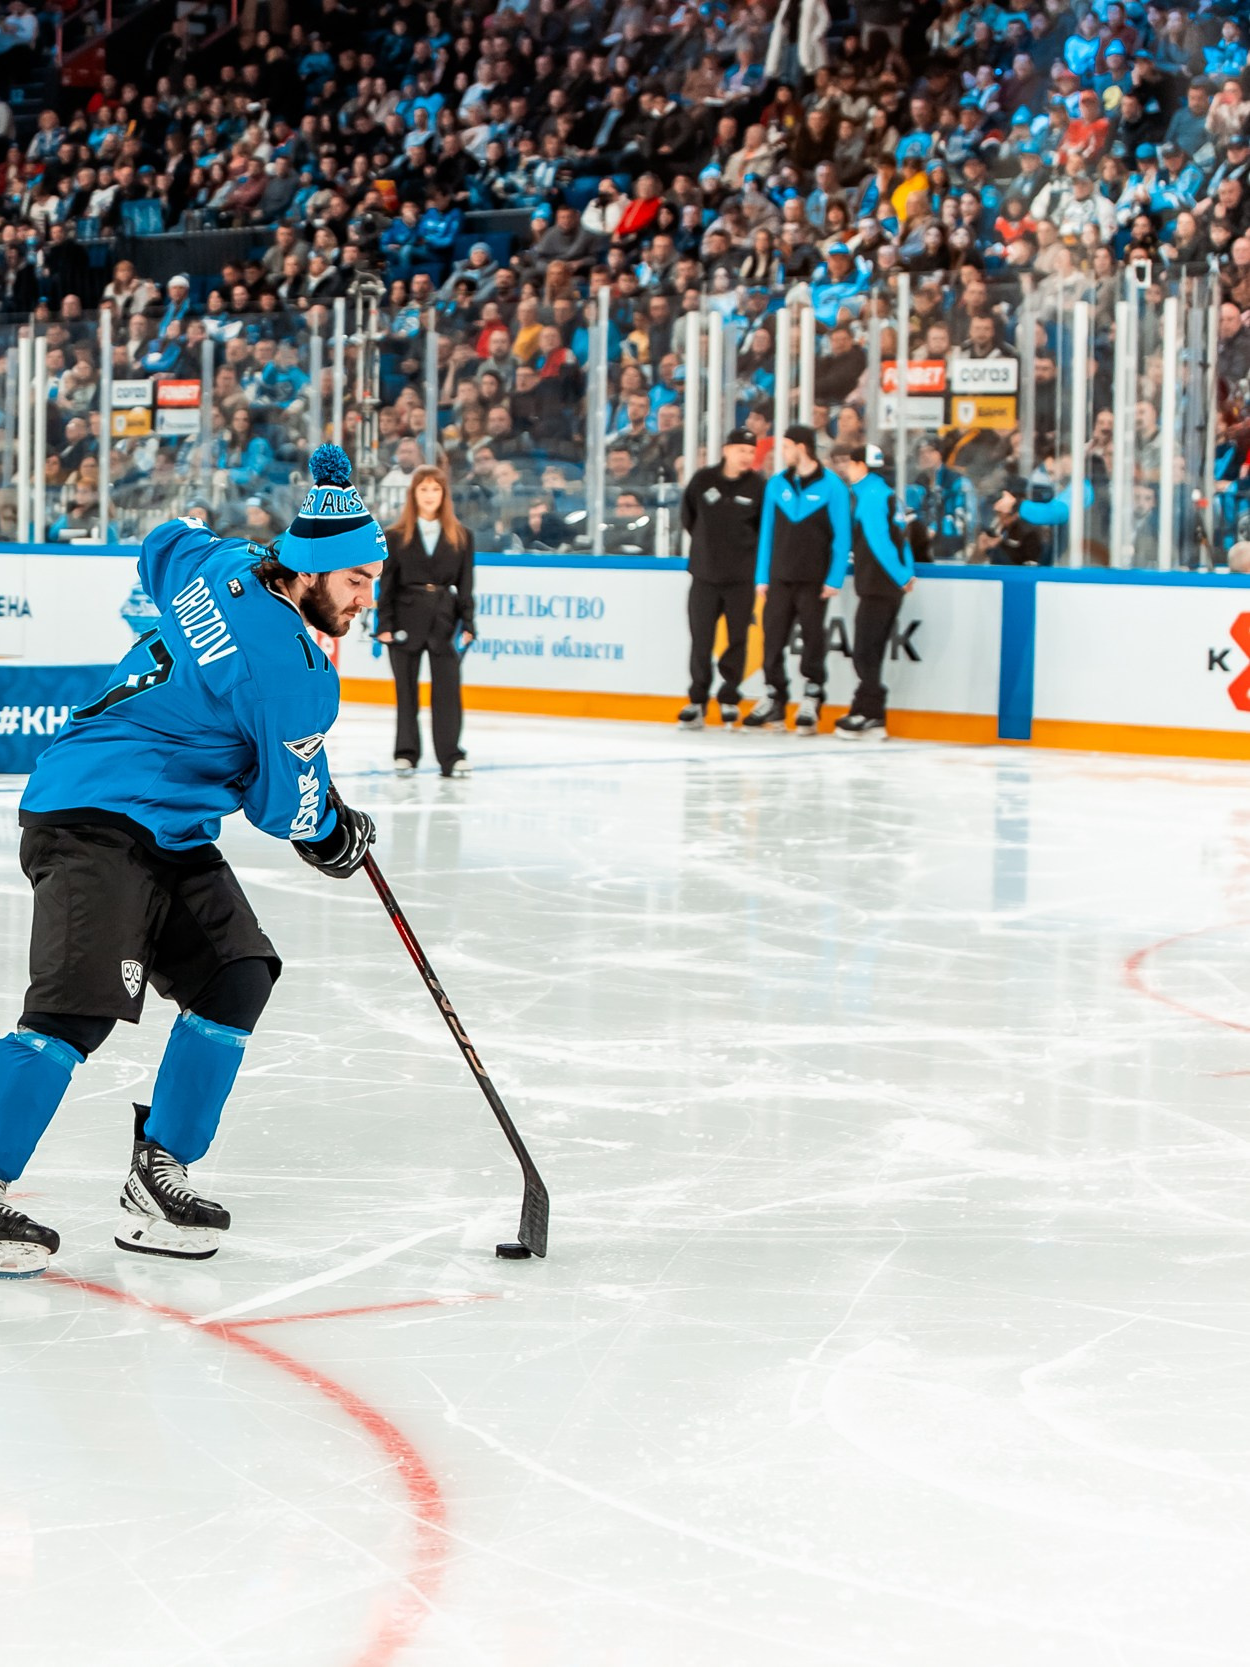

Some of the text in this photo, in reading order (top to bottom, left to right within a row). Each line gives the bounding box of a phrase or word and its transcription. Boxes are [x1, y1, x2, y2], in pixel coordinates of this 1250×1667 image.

[474, 593, 606, 620] ИТЕЛЬСТВО
[552, 635, 625, 660] области
[129, 1177, 150, 1207] CCM
